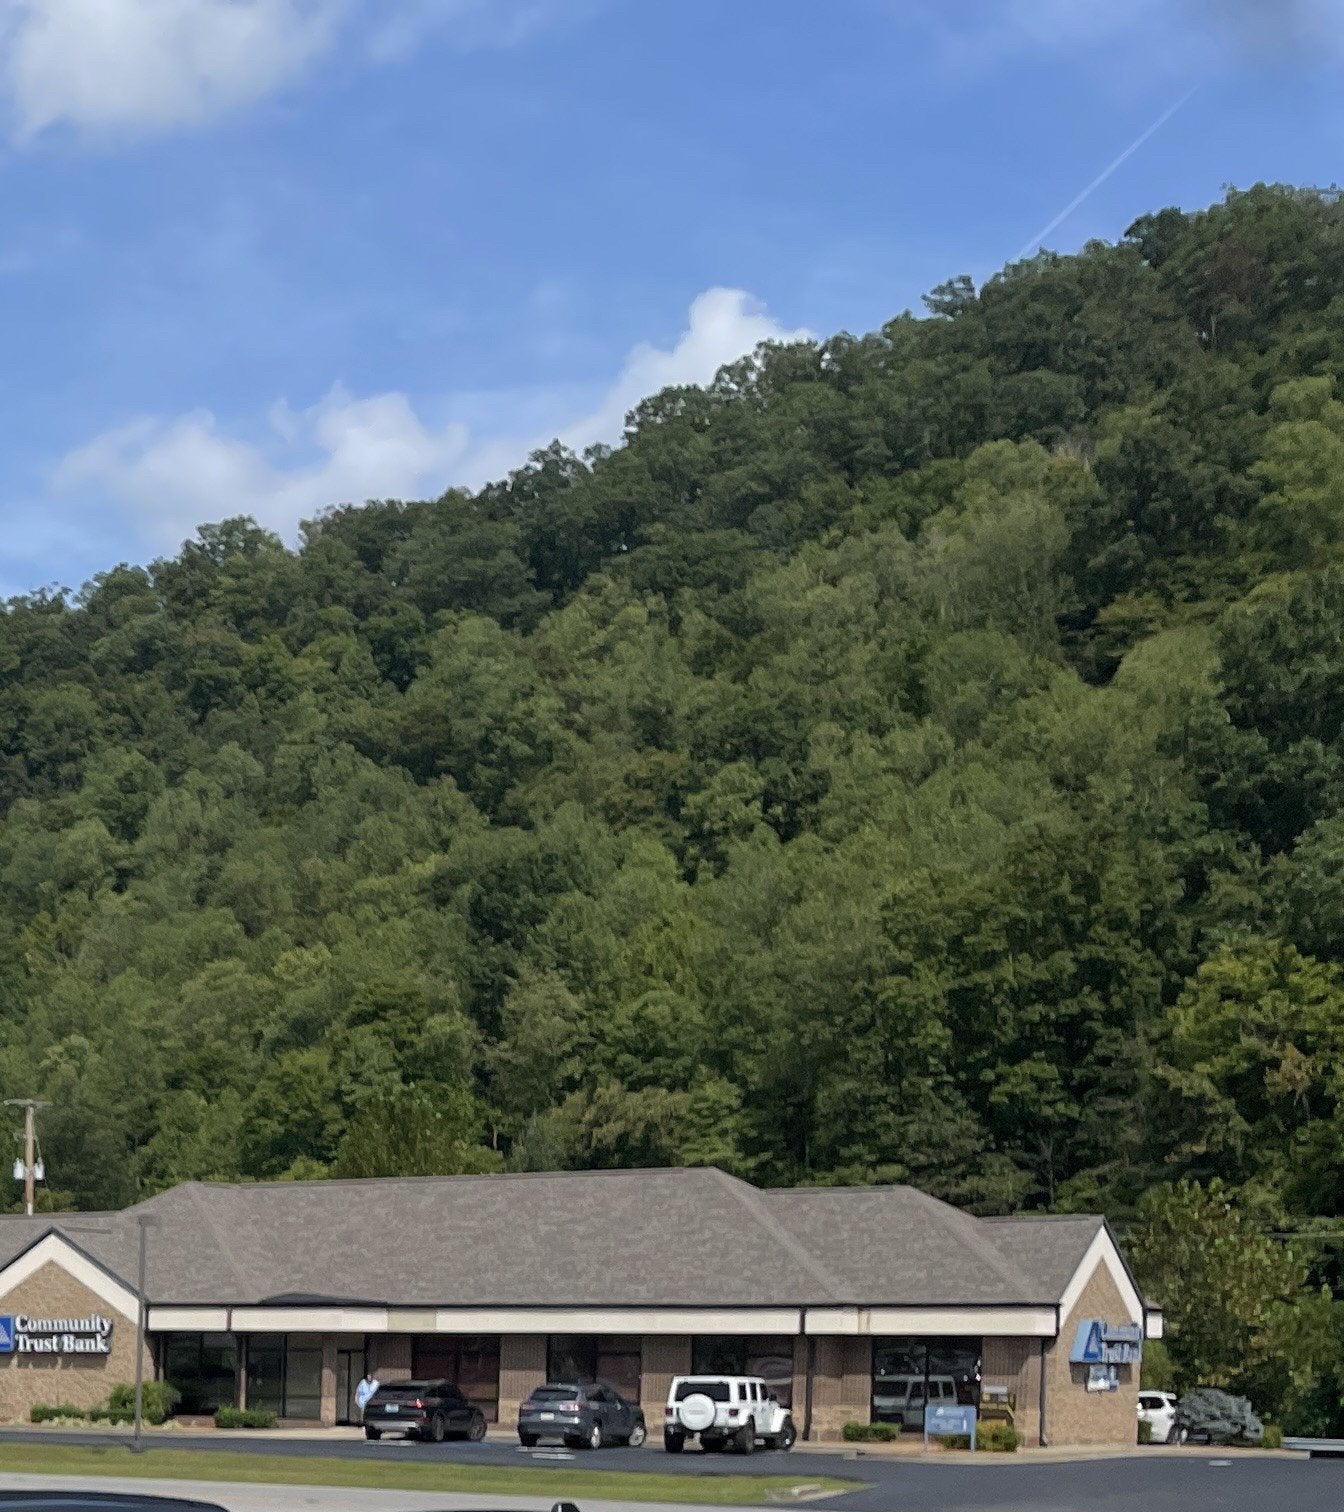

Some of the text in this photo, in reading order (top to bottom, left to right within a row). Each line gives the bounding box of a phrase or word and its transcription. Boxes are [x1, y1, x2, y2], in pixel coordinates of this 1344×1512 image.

[15, 1314, 111, 1336] Community
[15, 1333, 110, 1352] Trust Bank
